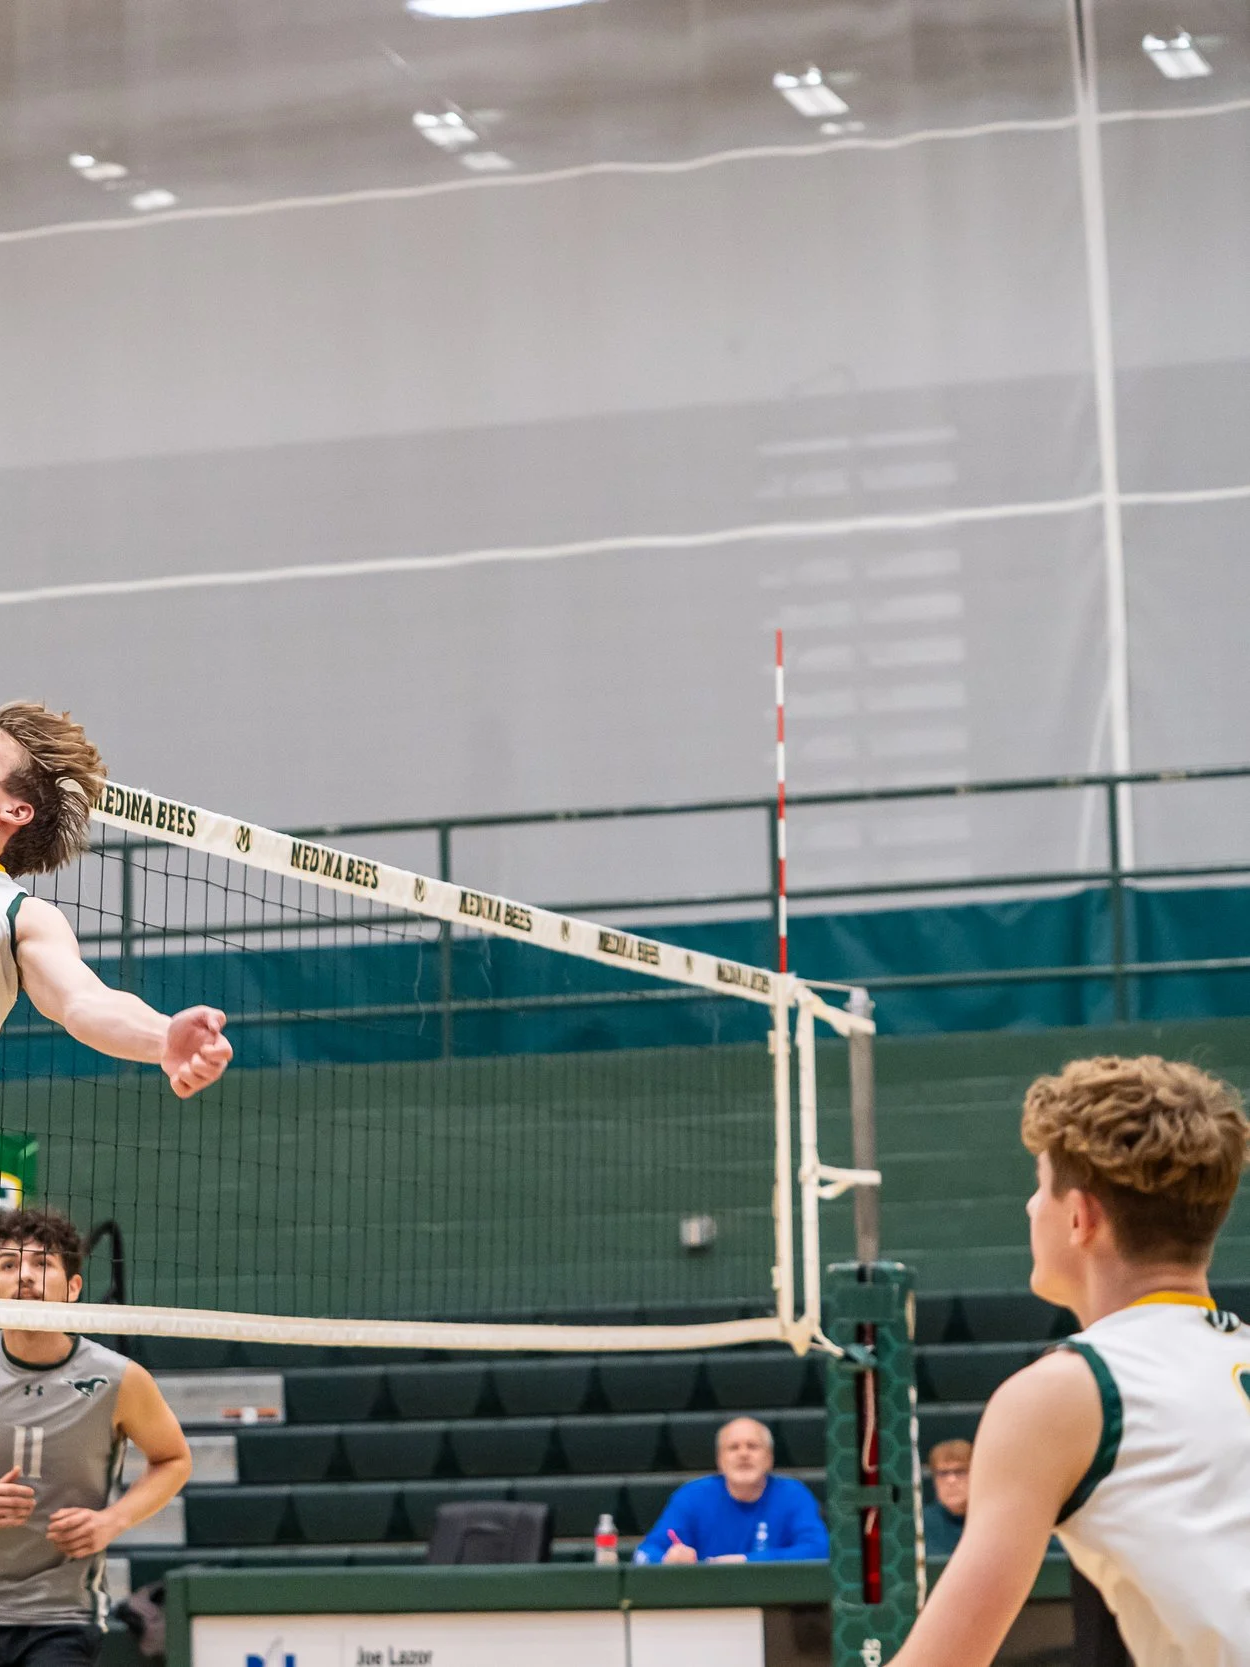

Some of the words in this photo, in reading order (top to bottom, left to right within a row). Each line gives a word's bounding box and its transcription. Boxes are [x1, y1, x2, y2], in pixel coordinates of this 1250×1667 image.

[156, 800, 198, 838] BEES
[345, 857, 380, 890] BEES
[13, 1425, 44, 1478] 11
